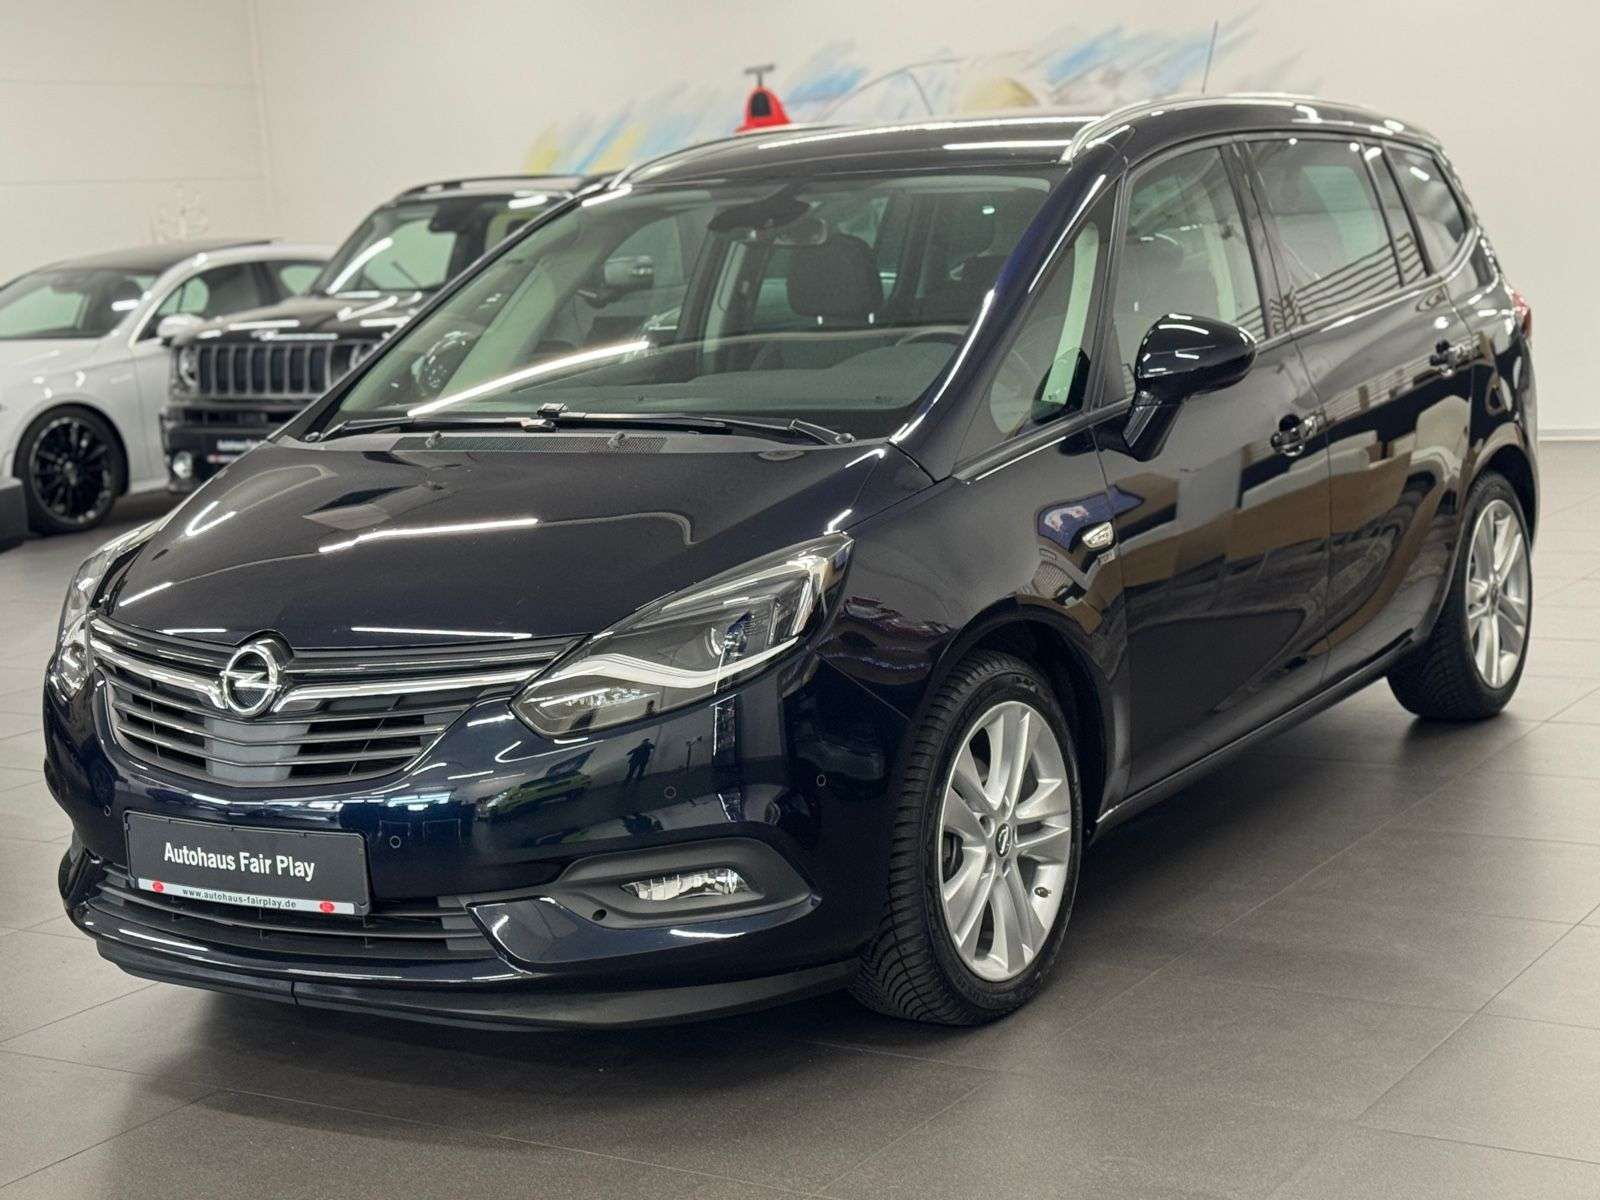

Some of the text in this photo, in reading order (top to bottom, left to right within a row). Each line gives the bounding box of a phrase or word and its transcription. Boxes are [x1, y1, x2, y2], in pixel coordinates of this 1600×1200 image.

[164, 842, 315, 882] Autohaus Fair Play
[182, 888, 297, 909] www.autohaus-fairplay.de
